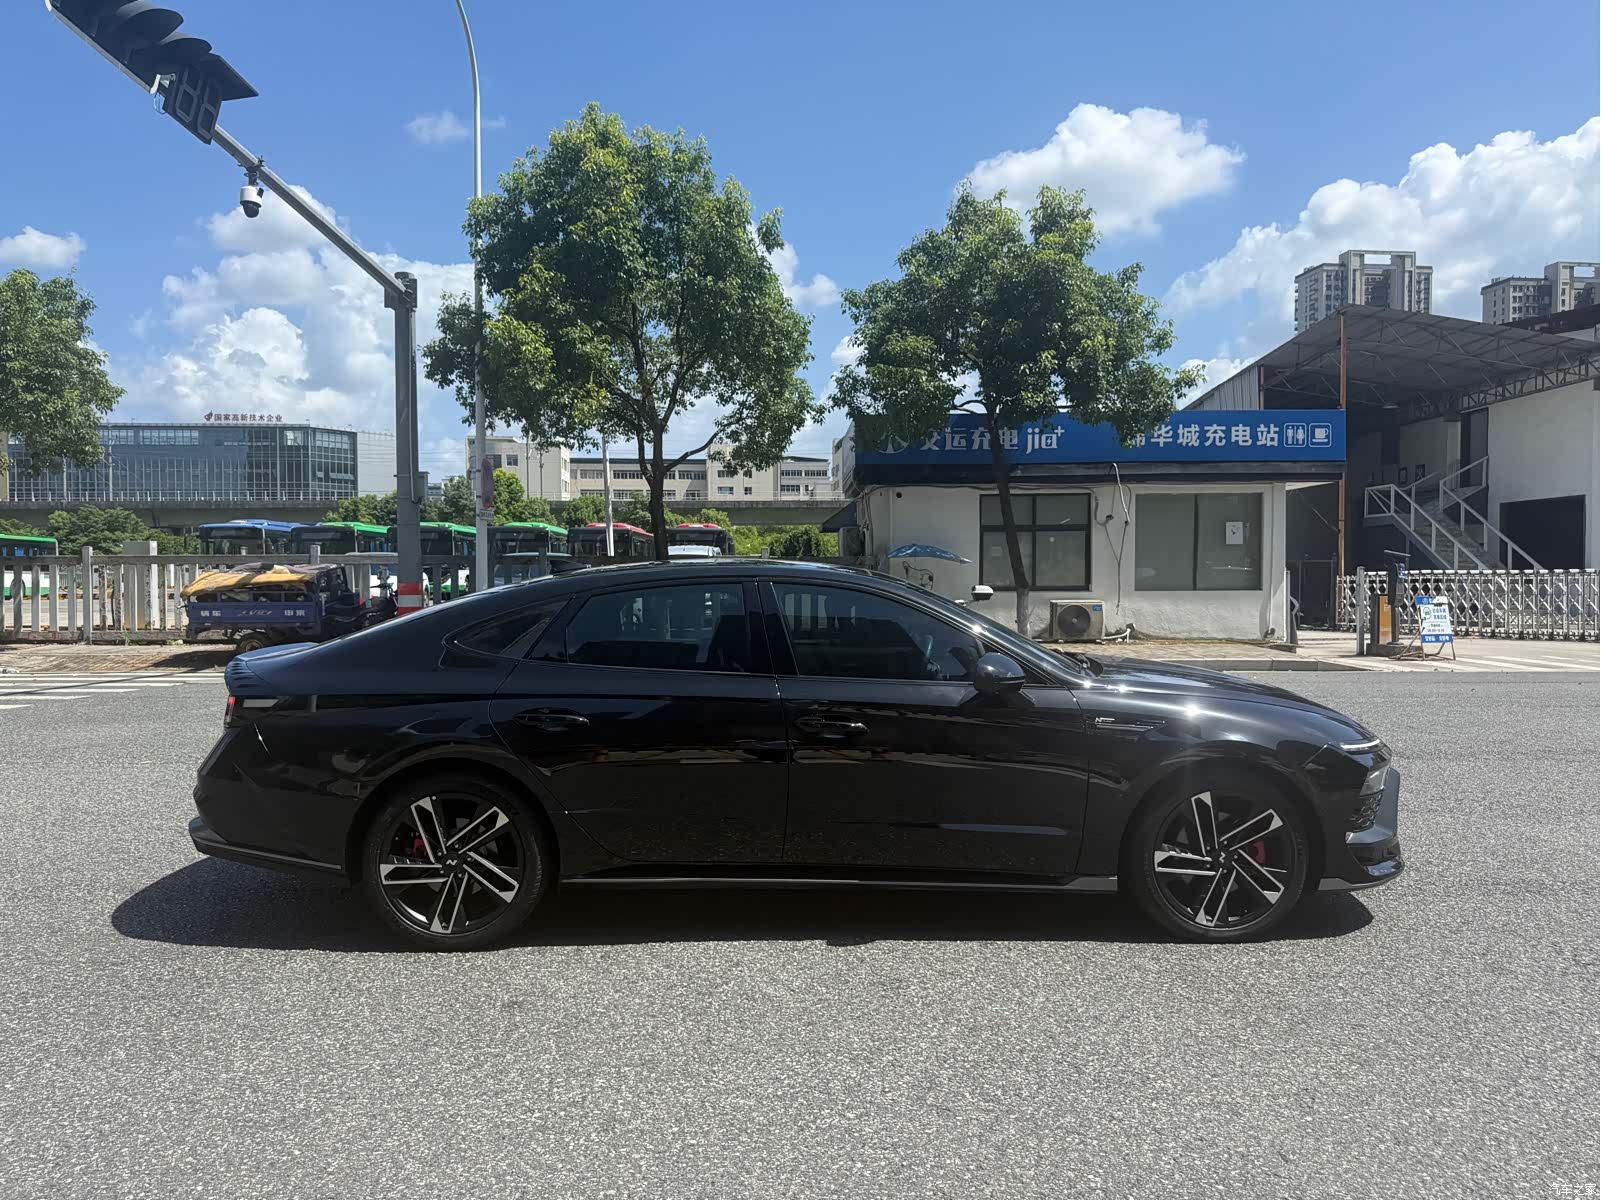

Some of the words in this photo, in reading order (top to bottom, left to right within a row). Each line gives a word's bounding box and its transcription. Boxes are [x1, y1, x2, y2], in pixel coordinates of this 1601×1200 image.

[214, 413, 283, 422] 国家高新技术企业
